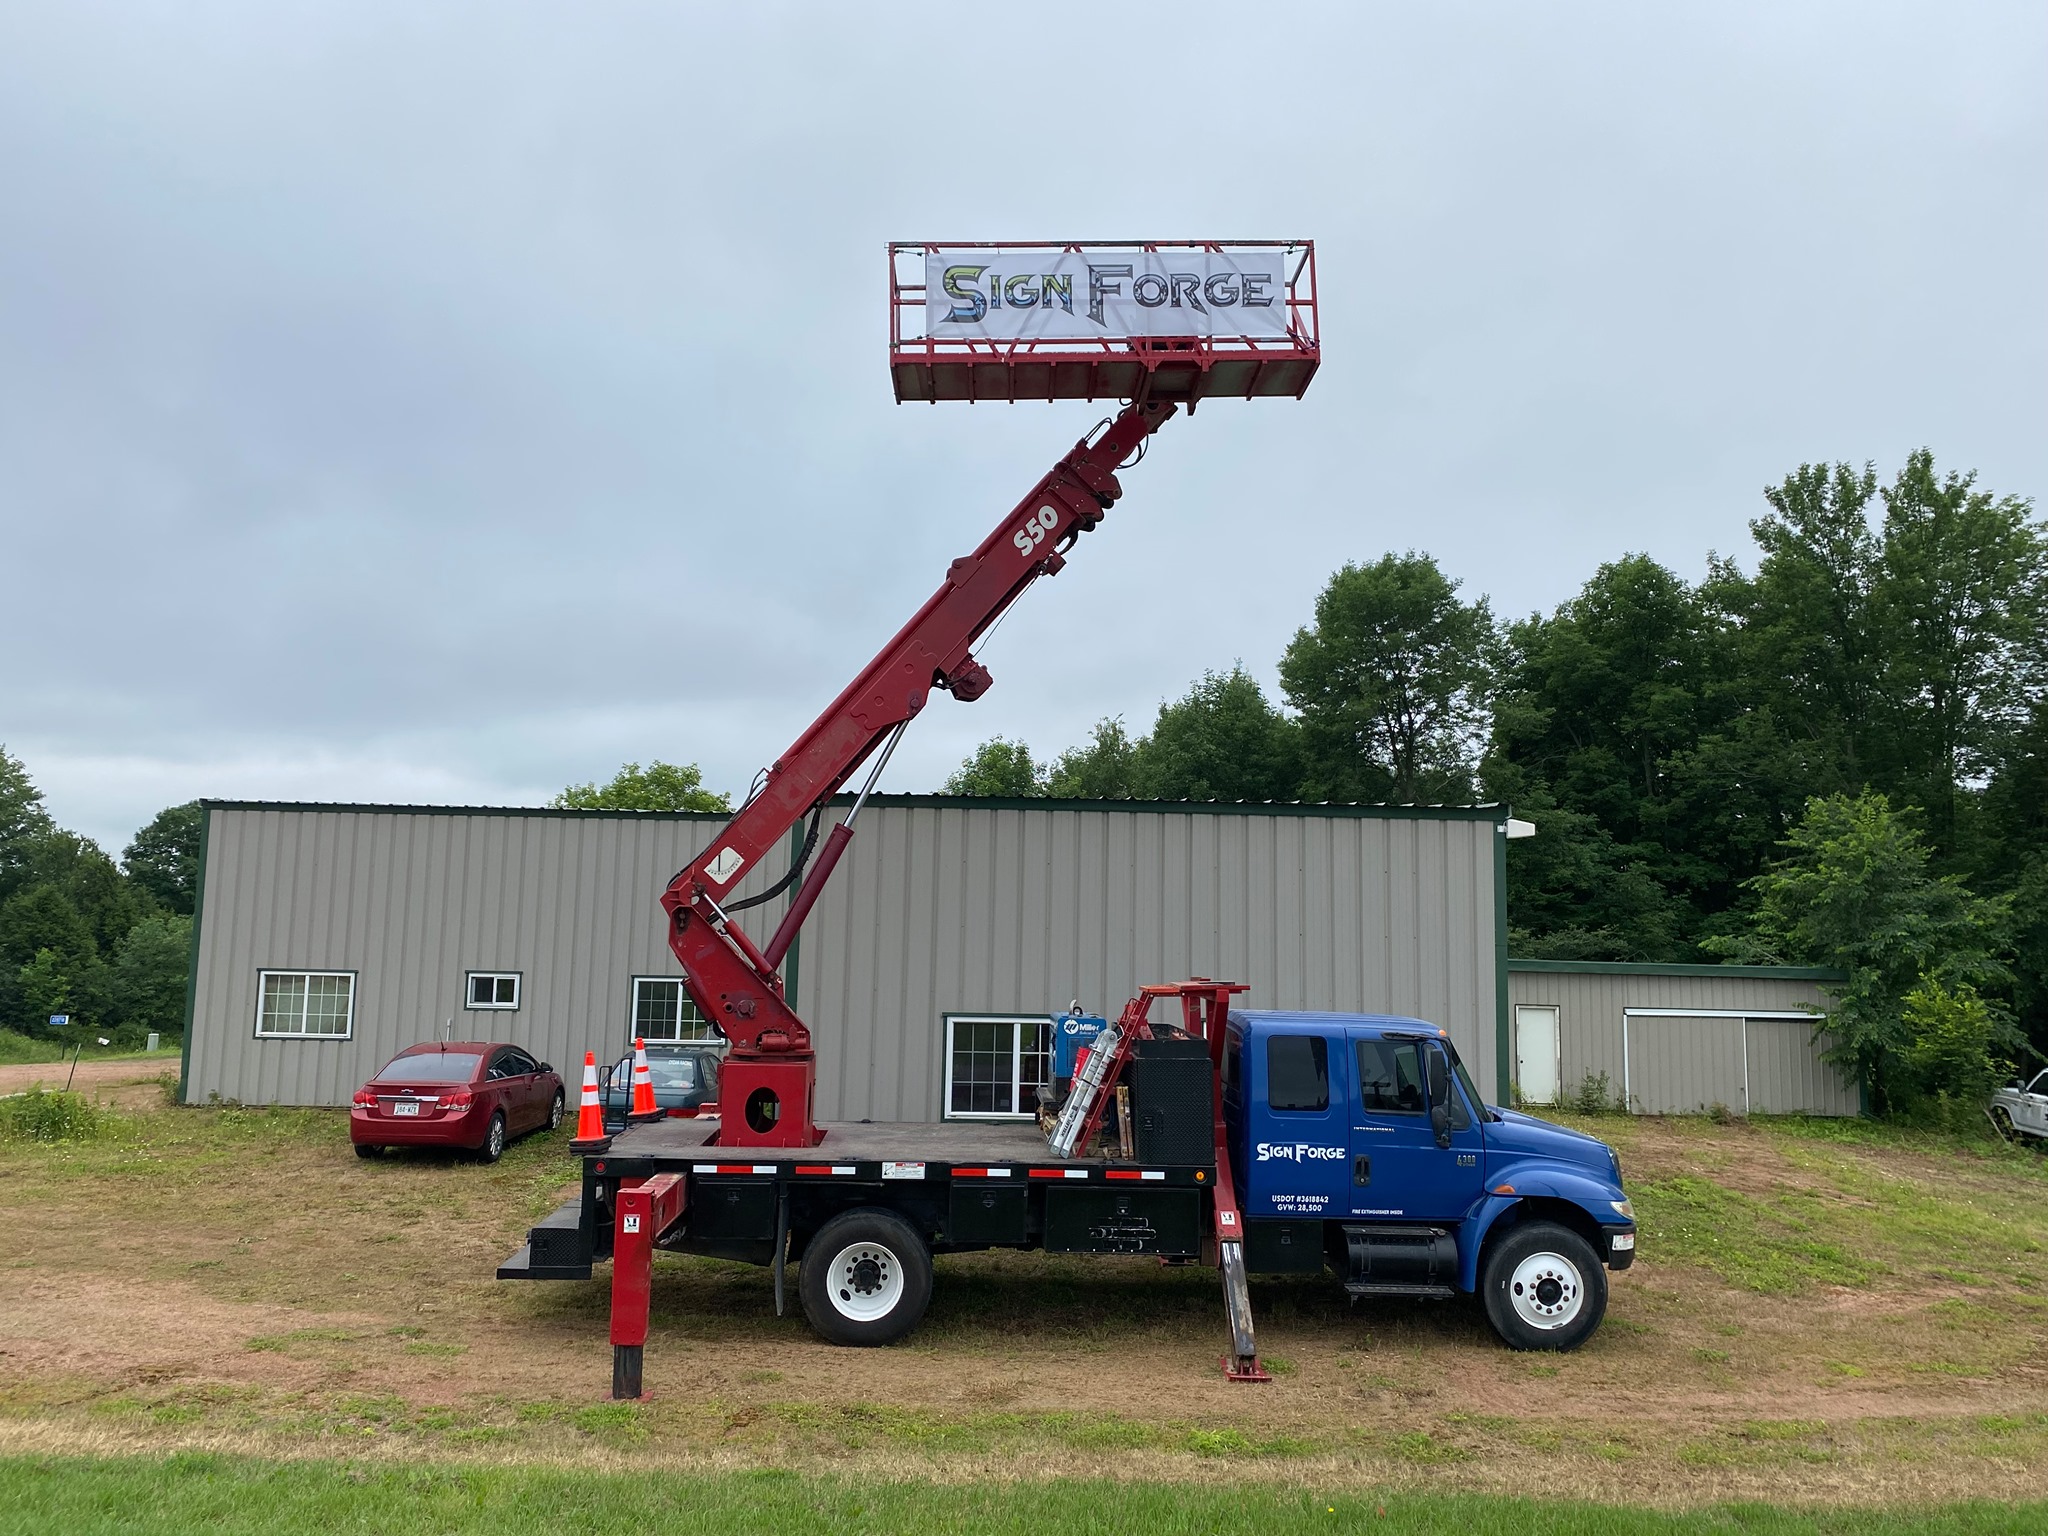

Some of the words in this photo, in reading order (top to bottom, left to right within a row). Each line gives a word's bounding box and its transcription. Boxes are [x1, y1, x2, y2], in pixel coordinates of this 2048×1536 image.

[939, 264, 1076, 324] SIGN
[1085, 264, 1275, 328] FORGE
[1013, 505, 1059, 557] S50
[1079, 1023, 1100, 1031] Miller
[1256, 1143, 1293, 1161] SIGN
[1295, 1144, 1346, 1164] FORGE
[1297, 1204, 1322, 1212] 28,500
